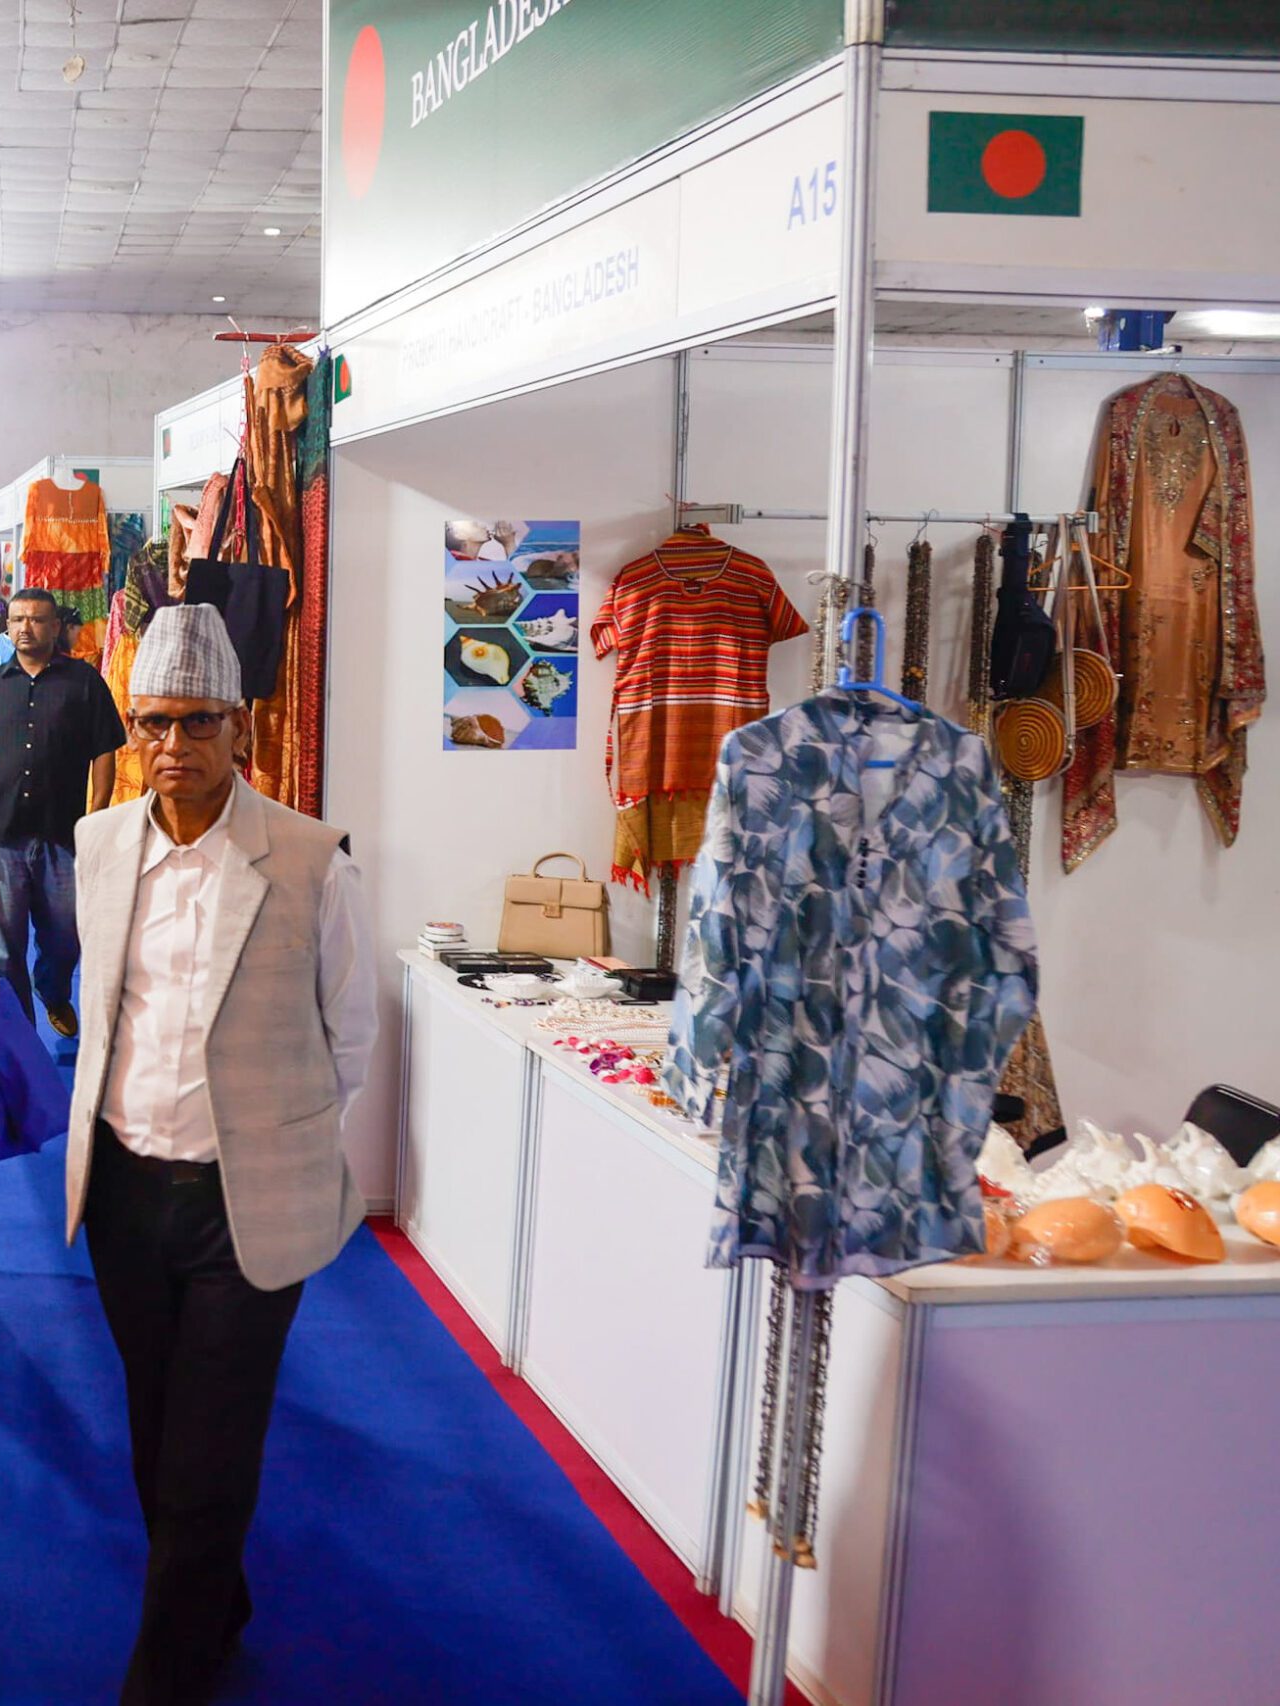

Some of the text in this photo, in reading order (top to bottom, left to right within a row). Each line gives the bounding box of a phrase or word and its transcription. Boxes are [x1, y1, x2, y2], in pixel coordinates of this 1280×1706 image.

[410, 0, 572, 128] BANGLADE
[787, 160, 837, 231] A15
[449, 295, 523, 354] HANDICRAFT
[532, 245, 640, 325] BANGLADESH
